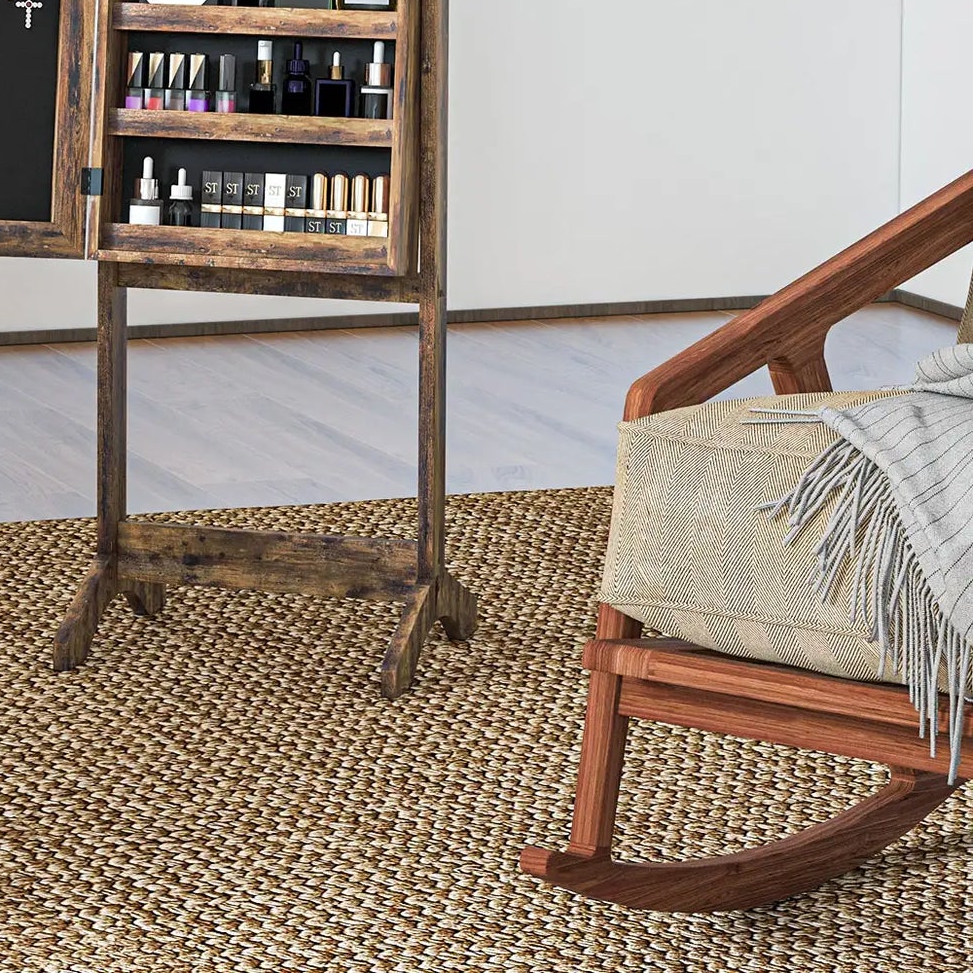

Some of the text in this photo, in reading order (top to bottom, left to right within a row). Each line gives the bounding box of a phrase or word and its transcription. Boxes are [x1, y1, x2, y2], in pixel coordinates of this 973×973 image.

[205, 182, 218, 194] ST
[226, 183, 239, 195] ST
[246, 184, 260, 196] ST
[269, 185, 282, 197] ST
[289, 186, 302, 198] ST
[308, 221, 322, 233] ST
[329, 222, 342, 234] ST
